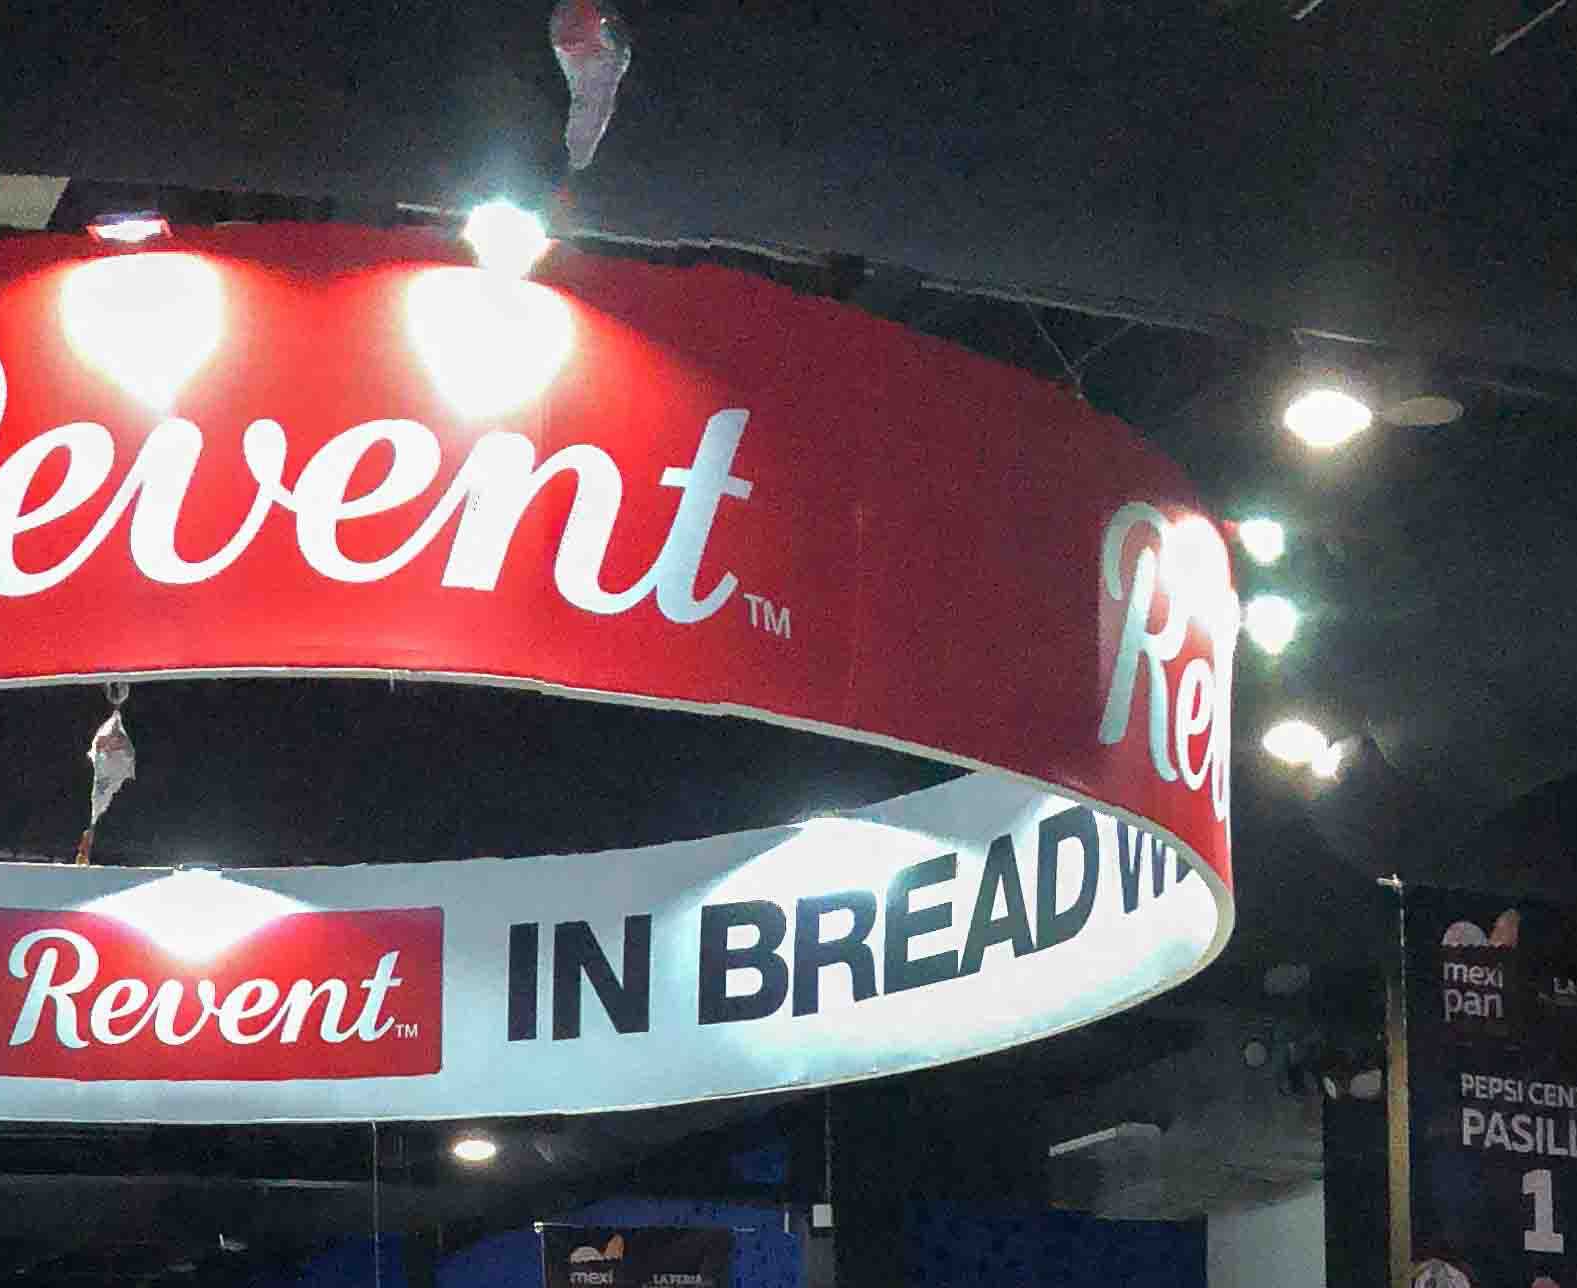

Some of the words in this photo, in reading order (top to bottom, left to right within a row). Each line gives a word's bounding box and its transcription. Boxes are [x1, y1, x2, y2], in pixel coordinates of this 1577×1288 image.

[507, 913, 651, 1041] IN
[698, 804, 1101, 1025] BREAD
[8, 929, 404, 1049] Revent
[1443, 959, 1505, 989] mexi
[1443, 988, 1505, 1022] pan
[1461, 1072, 1523, 1103] PEPSI
[1522, 1168, 1565, 1254] 1
[569, 1269, 614, 1286] mexi
